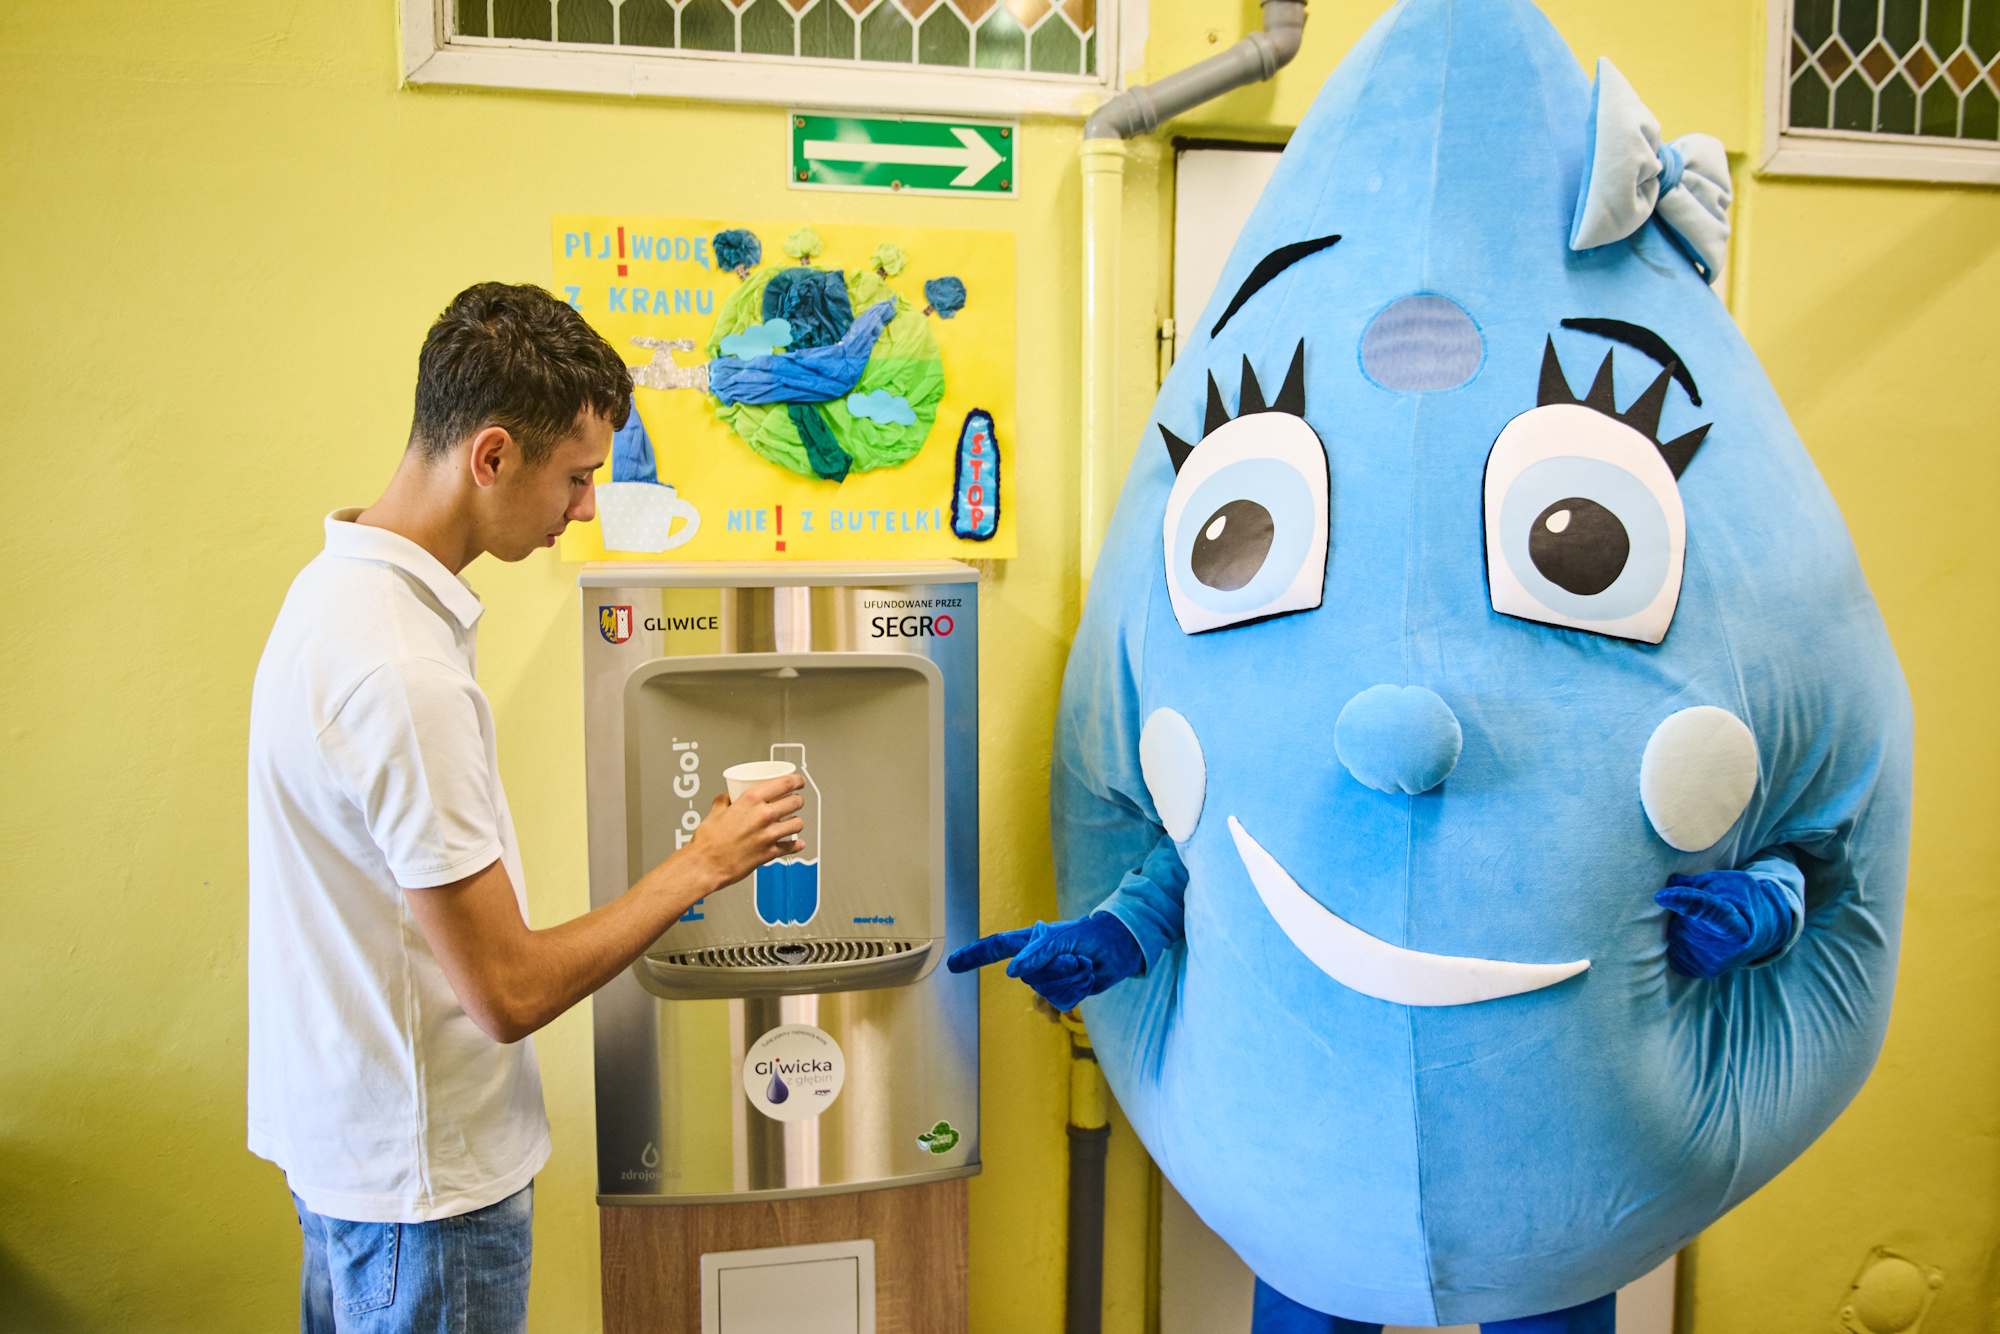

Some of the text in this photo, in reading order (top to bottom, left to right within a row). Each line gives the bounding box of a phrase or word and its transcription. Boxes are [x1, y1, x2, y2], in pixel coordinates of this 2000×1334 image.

[631, 233, 711, 272] WODĘ
[564, 286, 714, 315] Z KRANU
[967, 432, 985, 530] STOP
[800, 510, 814, 531] Z
[829, 507, 941, 532] BUTELKI
[864, 598, 962, 609] UFUNDOWANE PRZEZ
[644, 616, 719, 631] GLIWICE
[871, 614, 954, 638] SEGRO
[853, 914, 895, 925] murdock
[755, 1058, 832, 1075] Gliwicka
[786, 1077, 792, 1085] z
